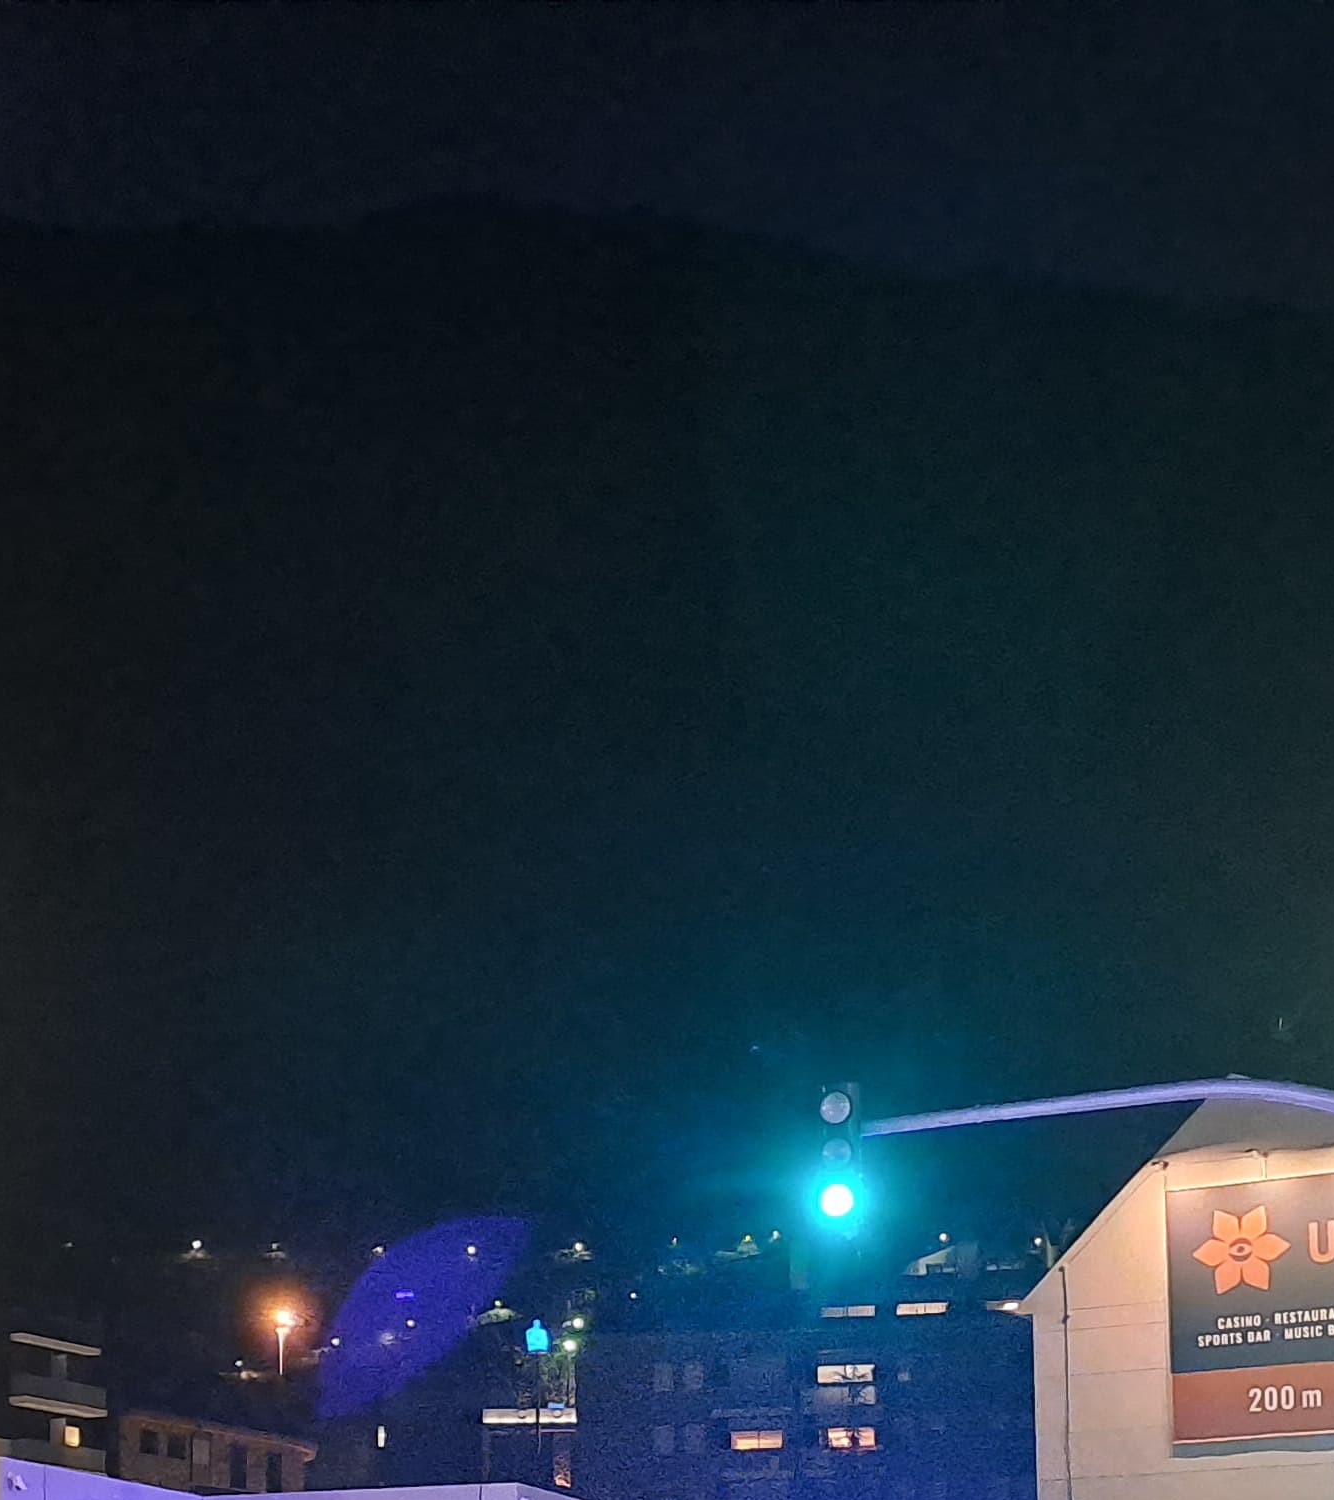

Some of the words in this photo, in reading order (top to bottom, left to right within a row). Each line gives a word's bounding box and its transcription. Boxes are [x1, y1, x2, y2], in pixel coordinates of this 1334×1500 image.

[1217, 1314, 1262, 1330] CASINO
[1197, 1331, 1243, 1348] SPORTS
[1247, 1329, 1271, 1343] BAR
[1284, 1324, 1323, 1340] MUSIC
[1248, 1385, 1294, 1412] 200
[1302, 1388, 1322, 1408] m
